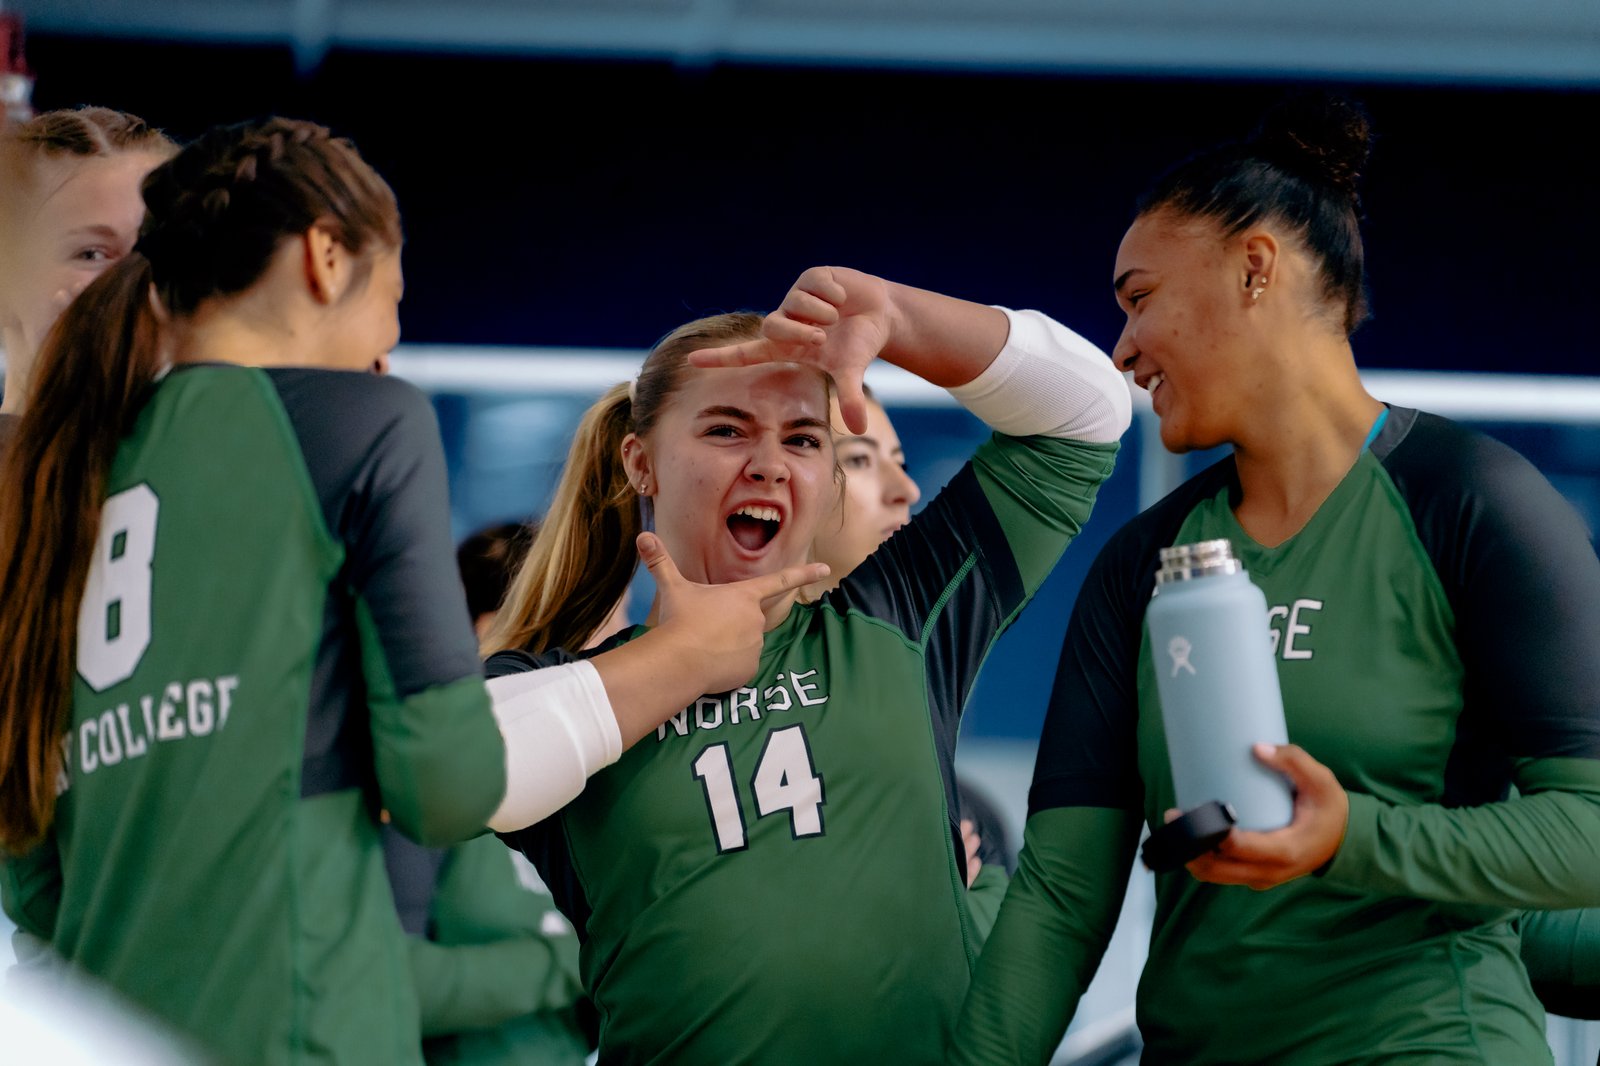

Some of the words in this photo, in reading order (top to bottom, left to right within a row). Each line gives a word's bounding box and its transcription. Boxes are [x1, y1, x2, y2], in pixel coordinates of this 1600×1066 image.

[76, 482, 160, 693] 8
[656, 669, 830, 742] NORSE
[691, 722, 827, 854] 14
